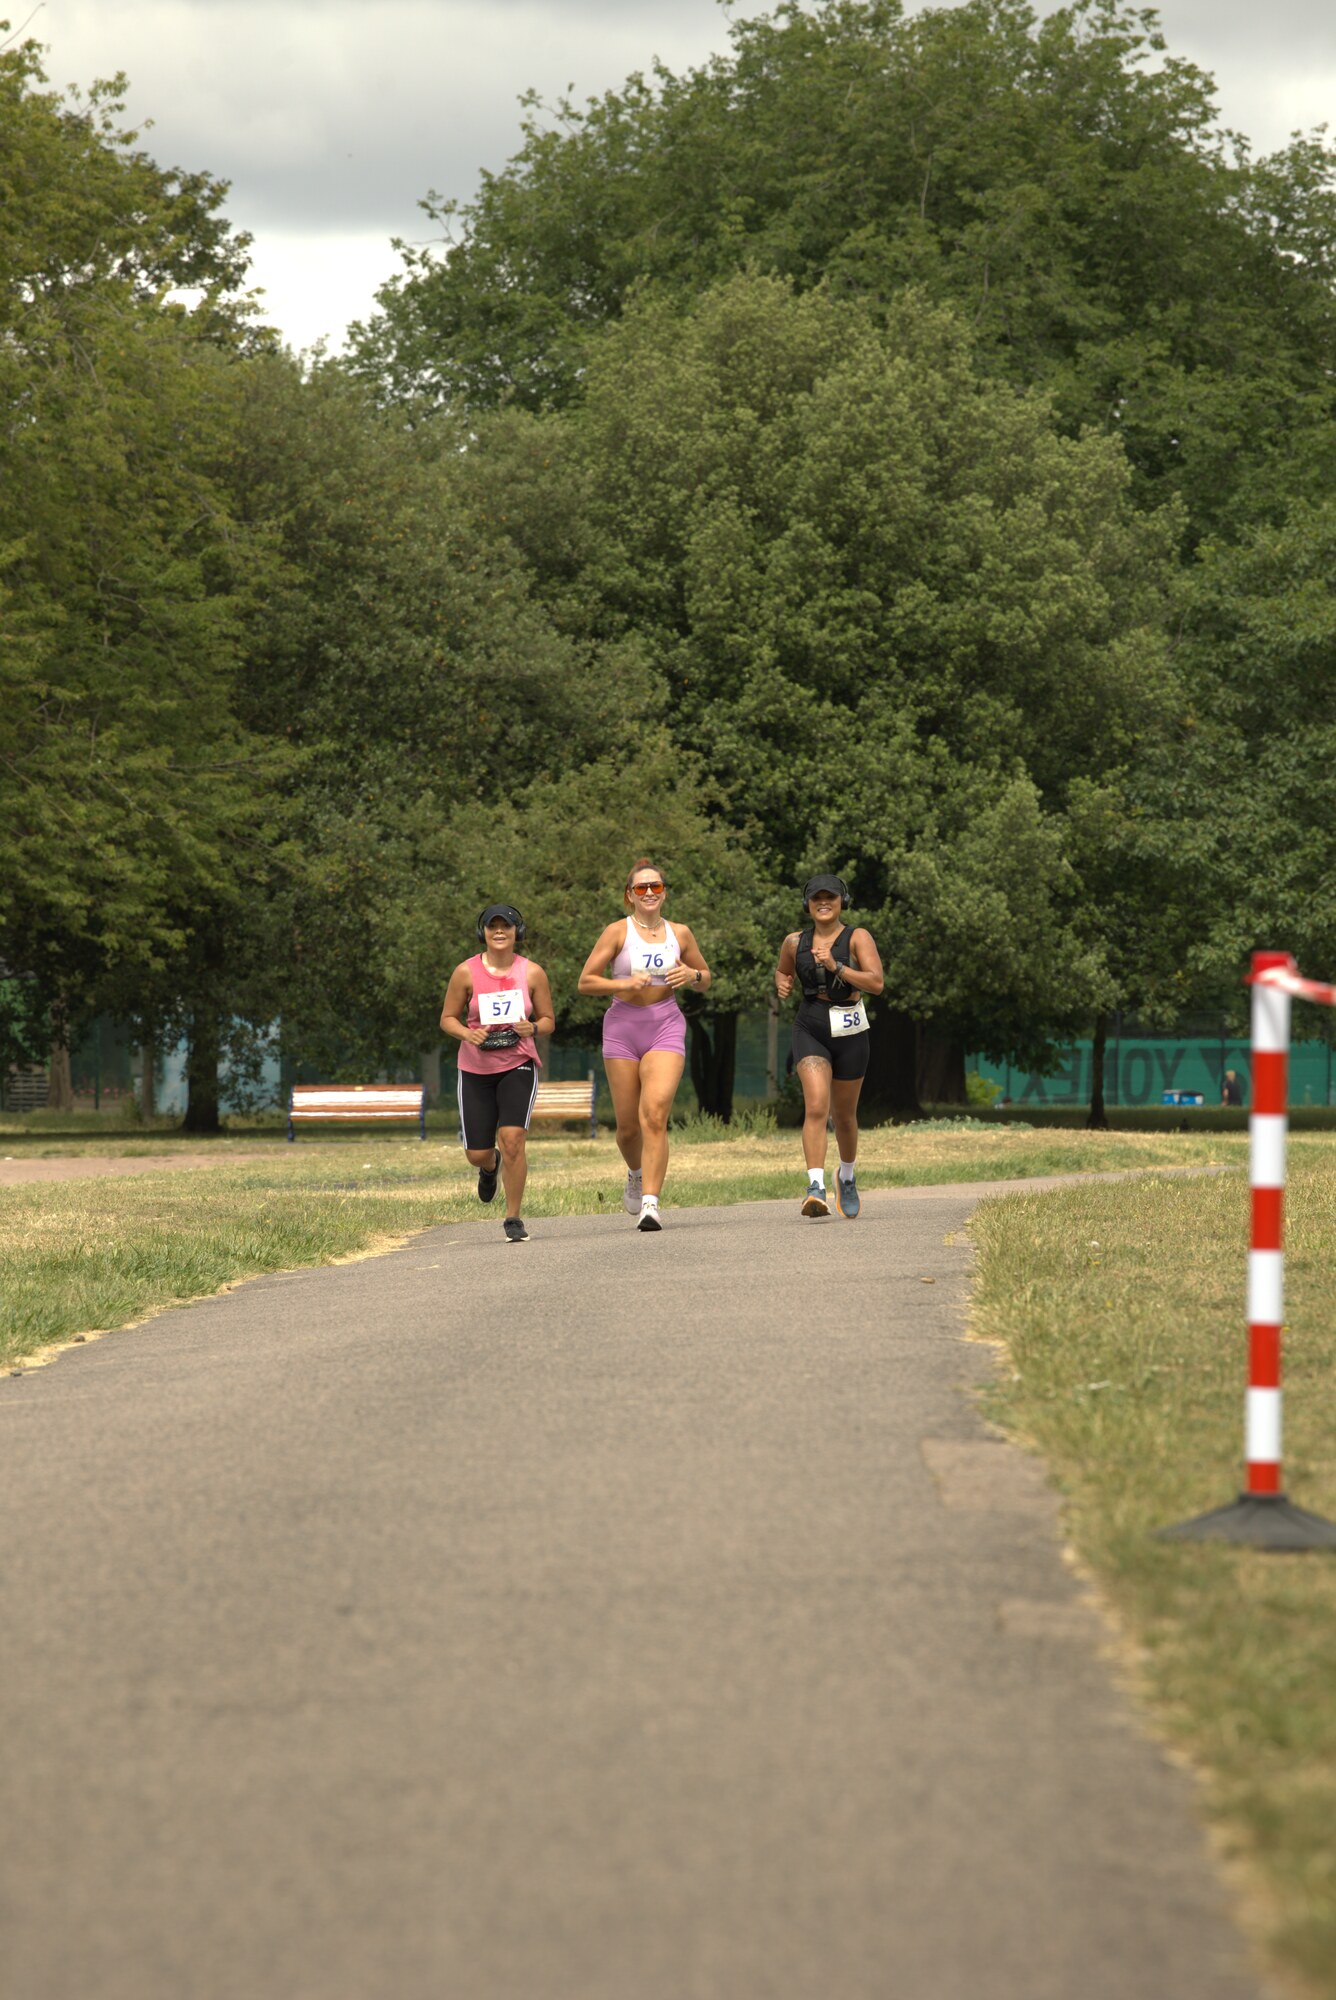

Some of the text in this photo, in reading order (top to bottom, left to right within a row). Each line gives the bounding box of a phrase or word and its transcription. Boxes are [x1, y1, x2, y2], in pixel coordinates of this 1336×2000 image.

[642, 953, 664, 968] 76
[492, 1000, 512, 1016] 57
[843, 1011, 861, 1029] 58
